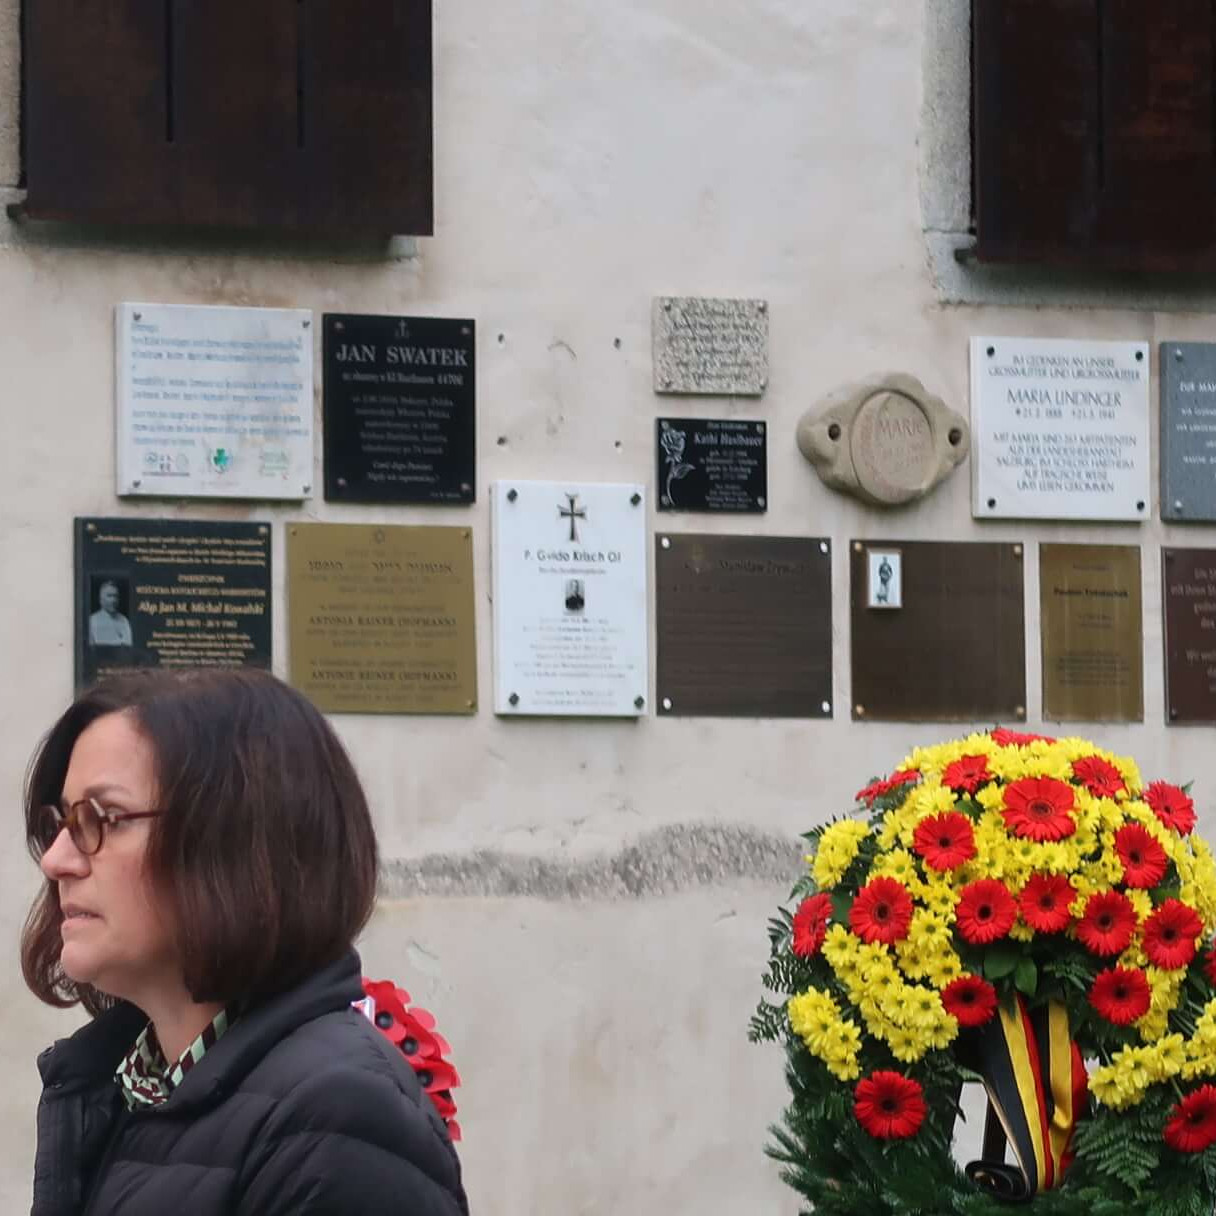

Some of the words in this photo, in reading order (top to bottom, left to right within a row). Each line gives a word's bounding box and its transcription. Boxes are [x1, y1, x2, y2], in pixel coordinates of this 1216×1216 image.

[336, 344, 376, 363] JAN
[386, 346, 469, 368] SWATEK
[1007, 388, 1052, 404] MARIA
[1056, 390, 1121, 407] LINDINGER
[537, 550, 570, 562] Guido
